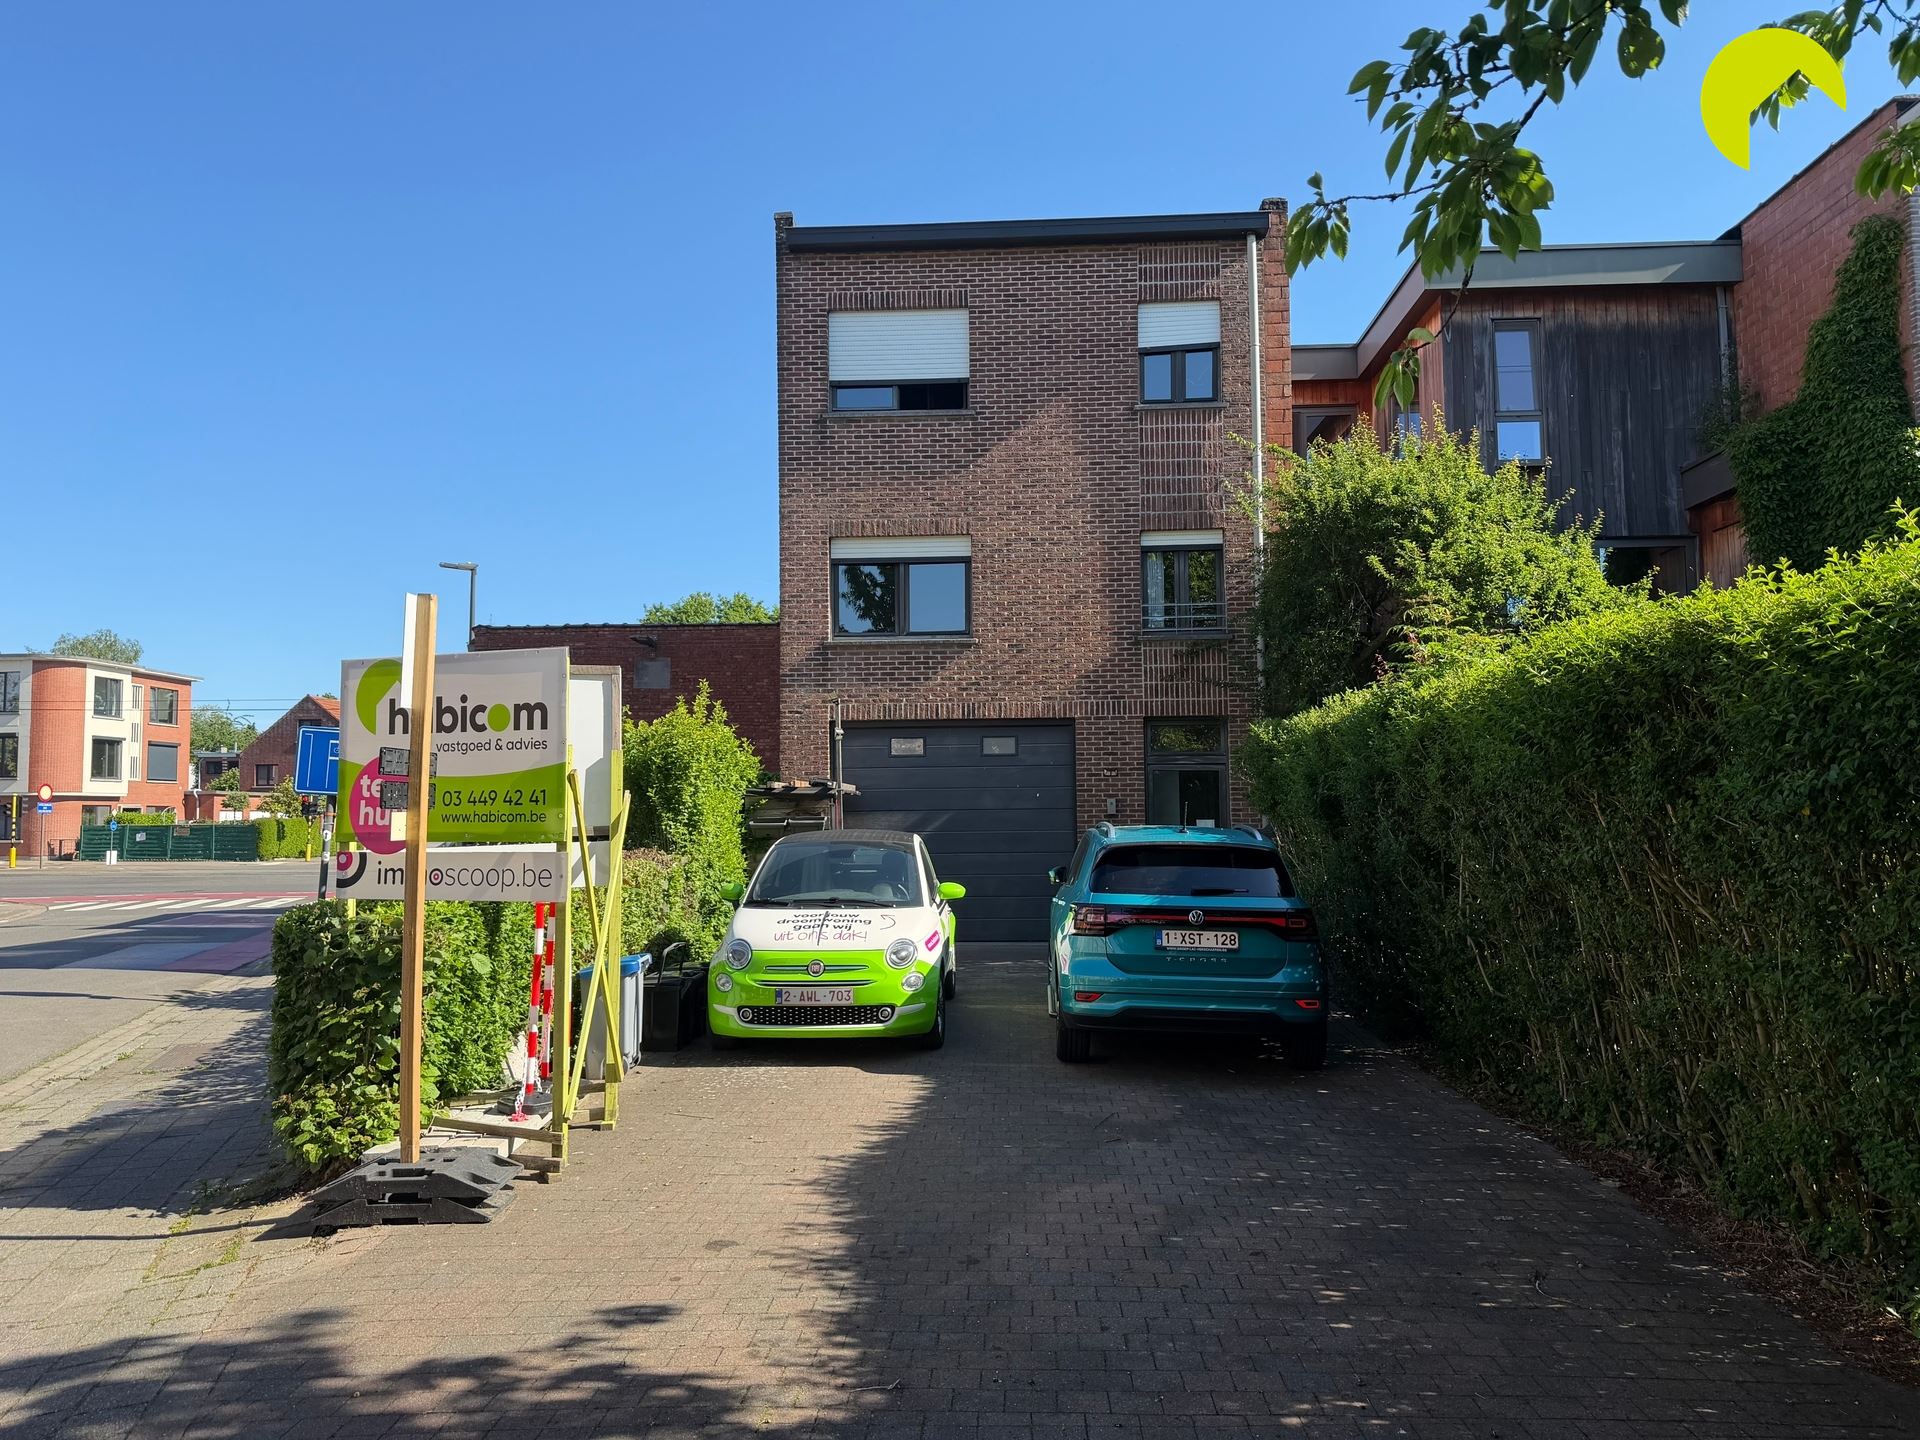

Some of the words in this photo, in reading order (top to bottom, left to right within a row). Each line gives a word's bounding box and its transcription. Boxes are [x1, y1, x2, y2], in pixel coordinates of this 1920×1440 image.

[388, 694, 548, 735] hbicom
[436, 738, 491, 755] vastgoed
[494, 738, 503, 751] &
[506, 737, 548, 751] advies
[360, 774, 384, 798] te
[442, 790, 462, 807] 03
[467, 789, 498, 806] 449
[502, 789, 523, 806] 42
[529, 789, 547, 806] 41
[358, 800, 391, 826] hu
[441, 810, 547, 823] www.habicom.be
[377, 860, 553, 892] imoscoop.be
[776, 917, 872, 925] droomwoning
[793, 923, 829, 931] gaan
[774, 931, 794, 941] uit
